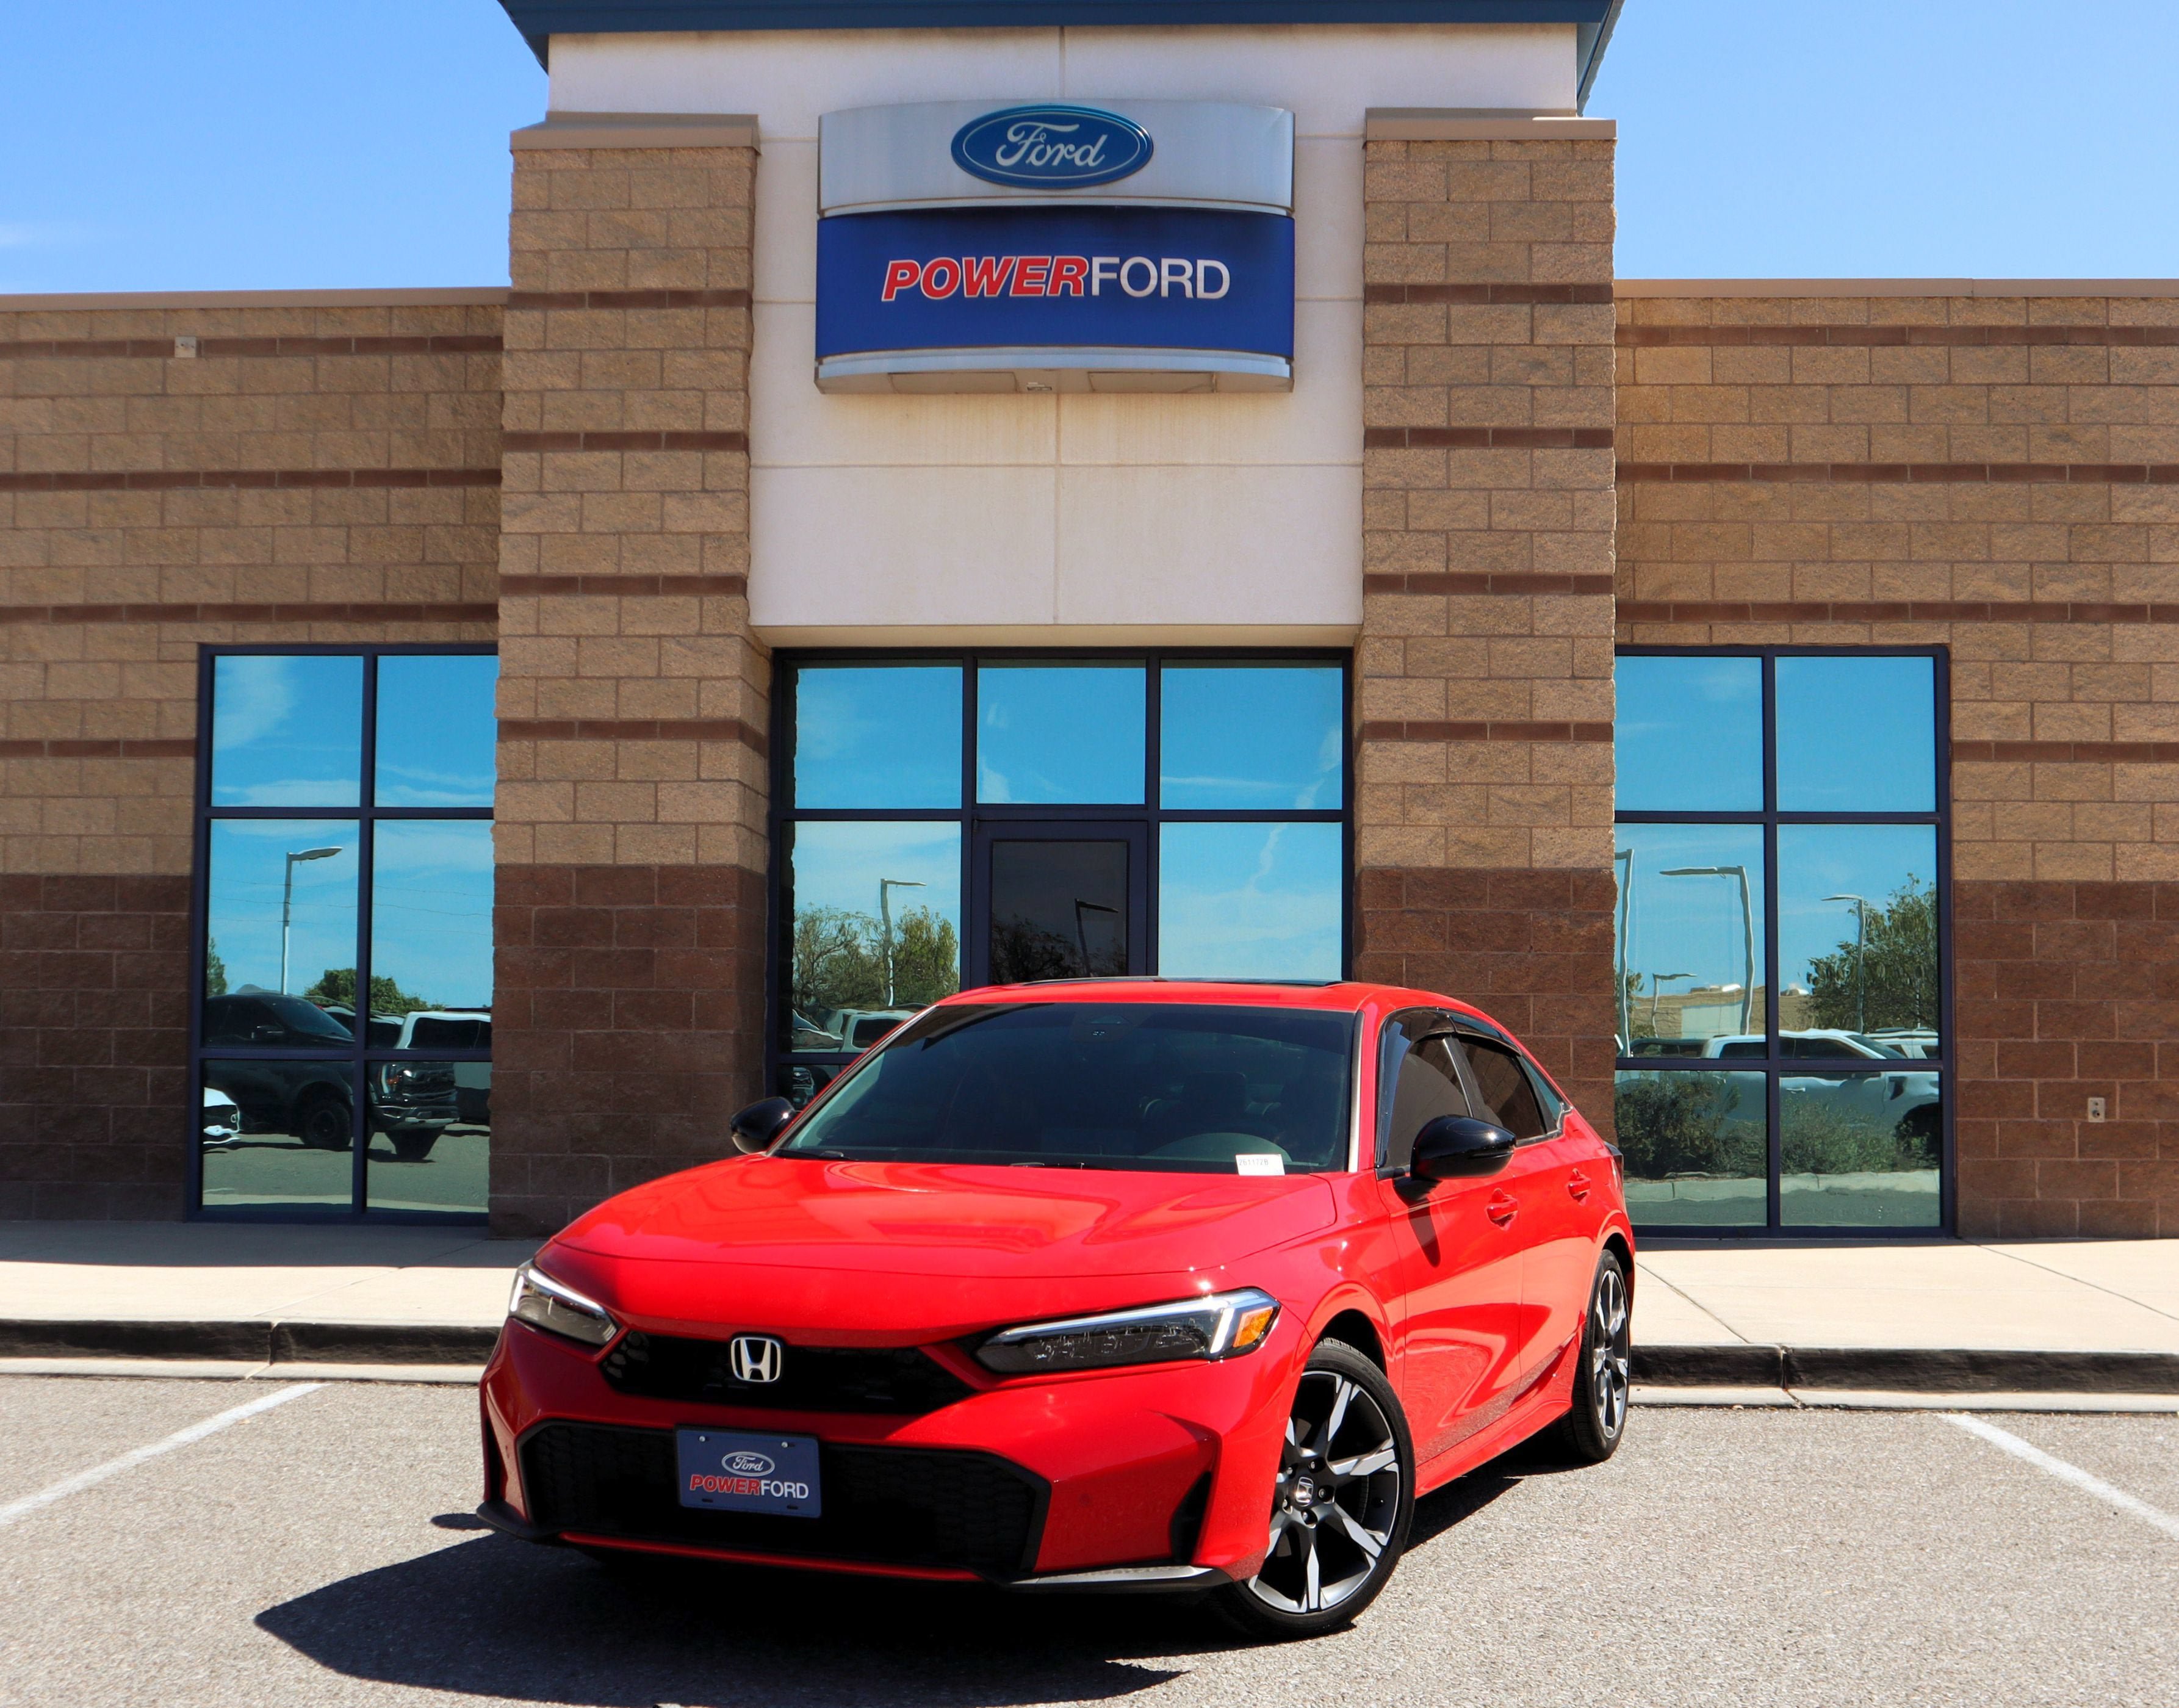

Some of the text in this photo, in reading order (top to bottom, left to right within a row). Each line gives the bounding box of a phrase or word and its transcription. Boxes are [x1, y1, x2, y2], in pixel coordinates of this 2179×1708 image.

[995, 122, 1106, 167] Ford
[881, 256, 1231, 302] POWERFORD
[732, 1455, 764, 1472] Ford
[690, 1474, 809, 1499] POWERFORD
